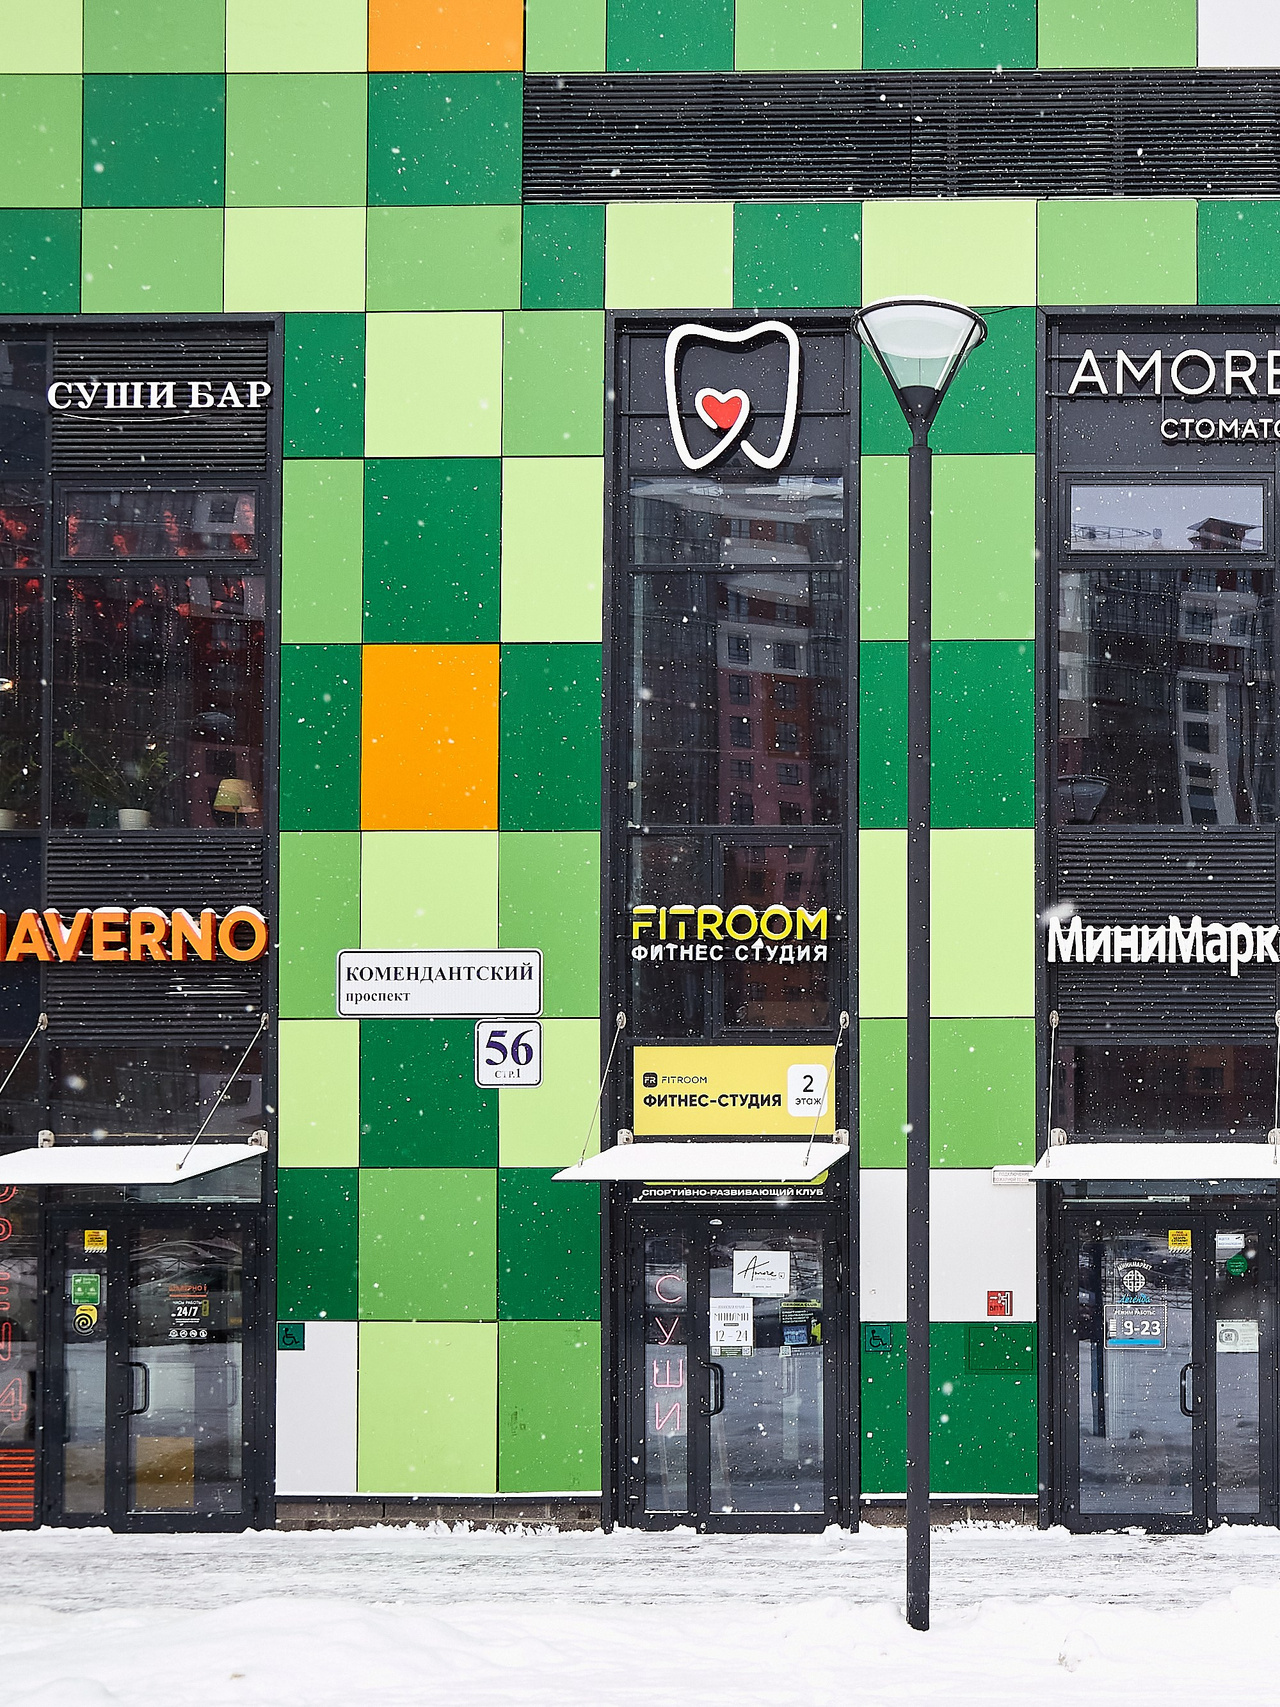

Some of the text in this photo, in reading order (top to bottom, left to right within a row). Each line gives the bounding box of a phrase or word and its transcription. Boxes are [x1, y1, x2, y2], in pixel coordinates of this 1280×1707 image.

[47, 380, 273, 410] СУШИ БАР
[632, 905, 828, 941] FITROOM
[0, 906, 269, 962] AVERNO
[631, 944, 828, 964] ФИТНЕС СТУДИЯ
[345, 962, 534, 984] КОМЕНДАНТСКИЙ
[345, 991, 411, 1004] проспект
[485, 1029, 534, 1066] 56
[661, 1076, 708, 1084] FITROOM
[802, 1074, 814, 1093] 2
[643, 1093, 782, 1110] ФИТНЕС-СТУДИЯ
[795, 1097, 822, 1106] этаж
[641, 1187, 824, 1198] СПОРТИВНО-РАЗВИВАЮЩИЙ КЛУБ
[176, 1306, 199, 1317] 24/7
[715, 1329, 725, 1342] 12
[1123, 1320, 1161, 1336] 9-23
